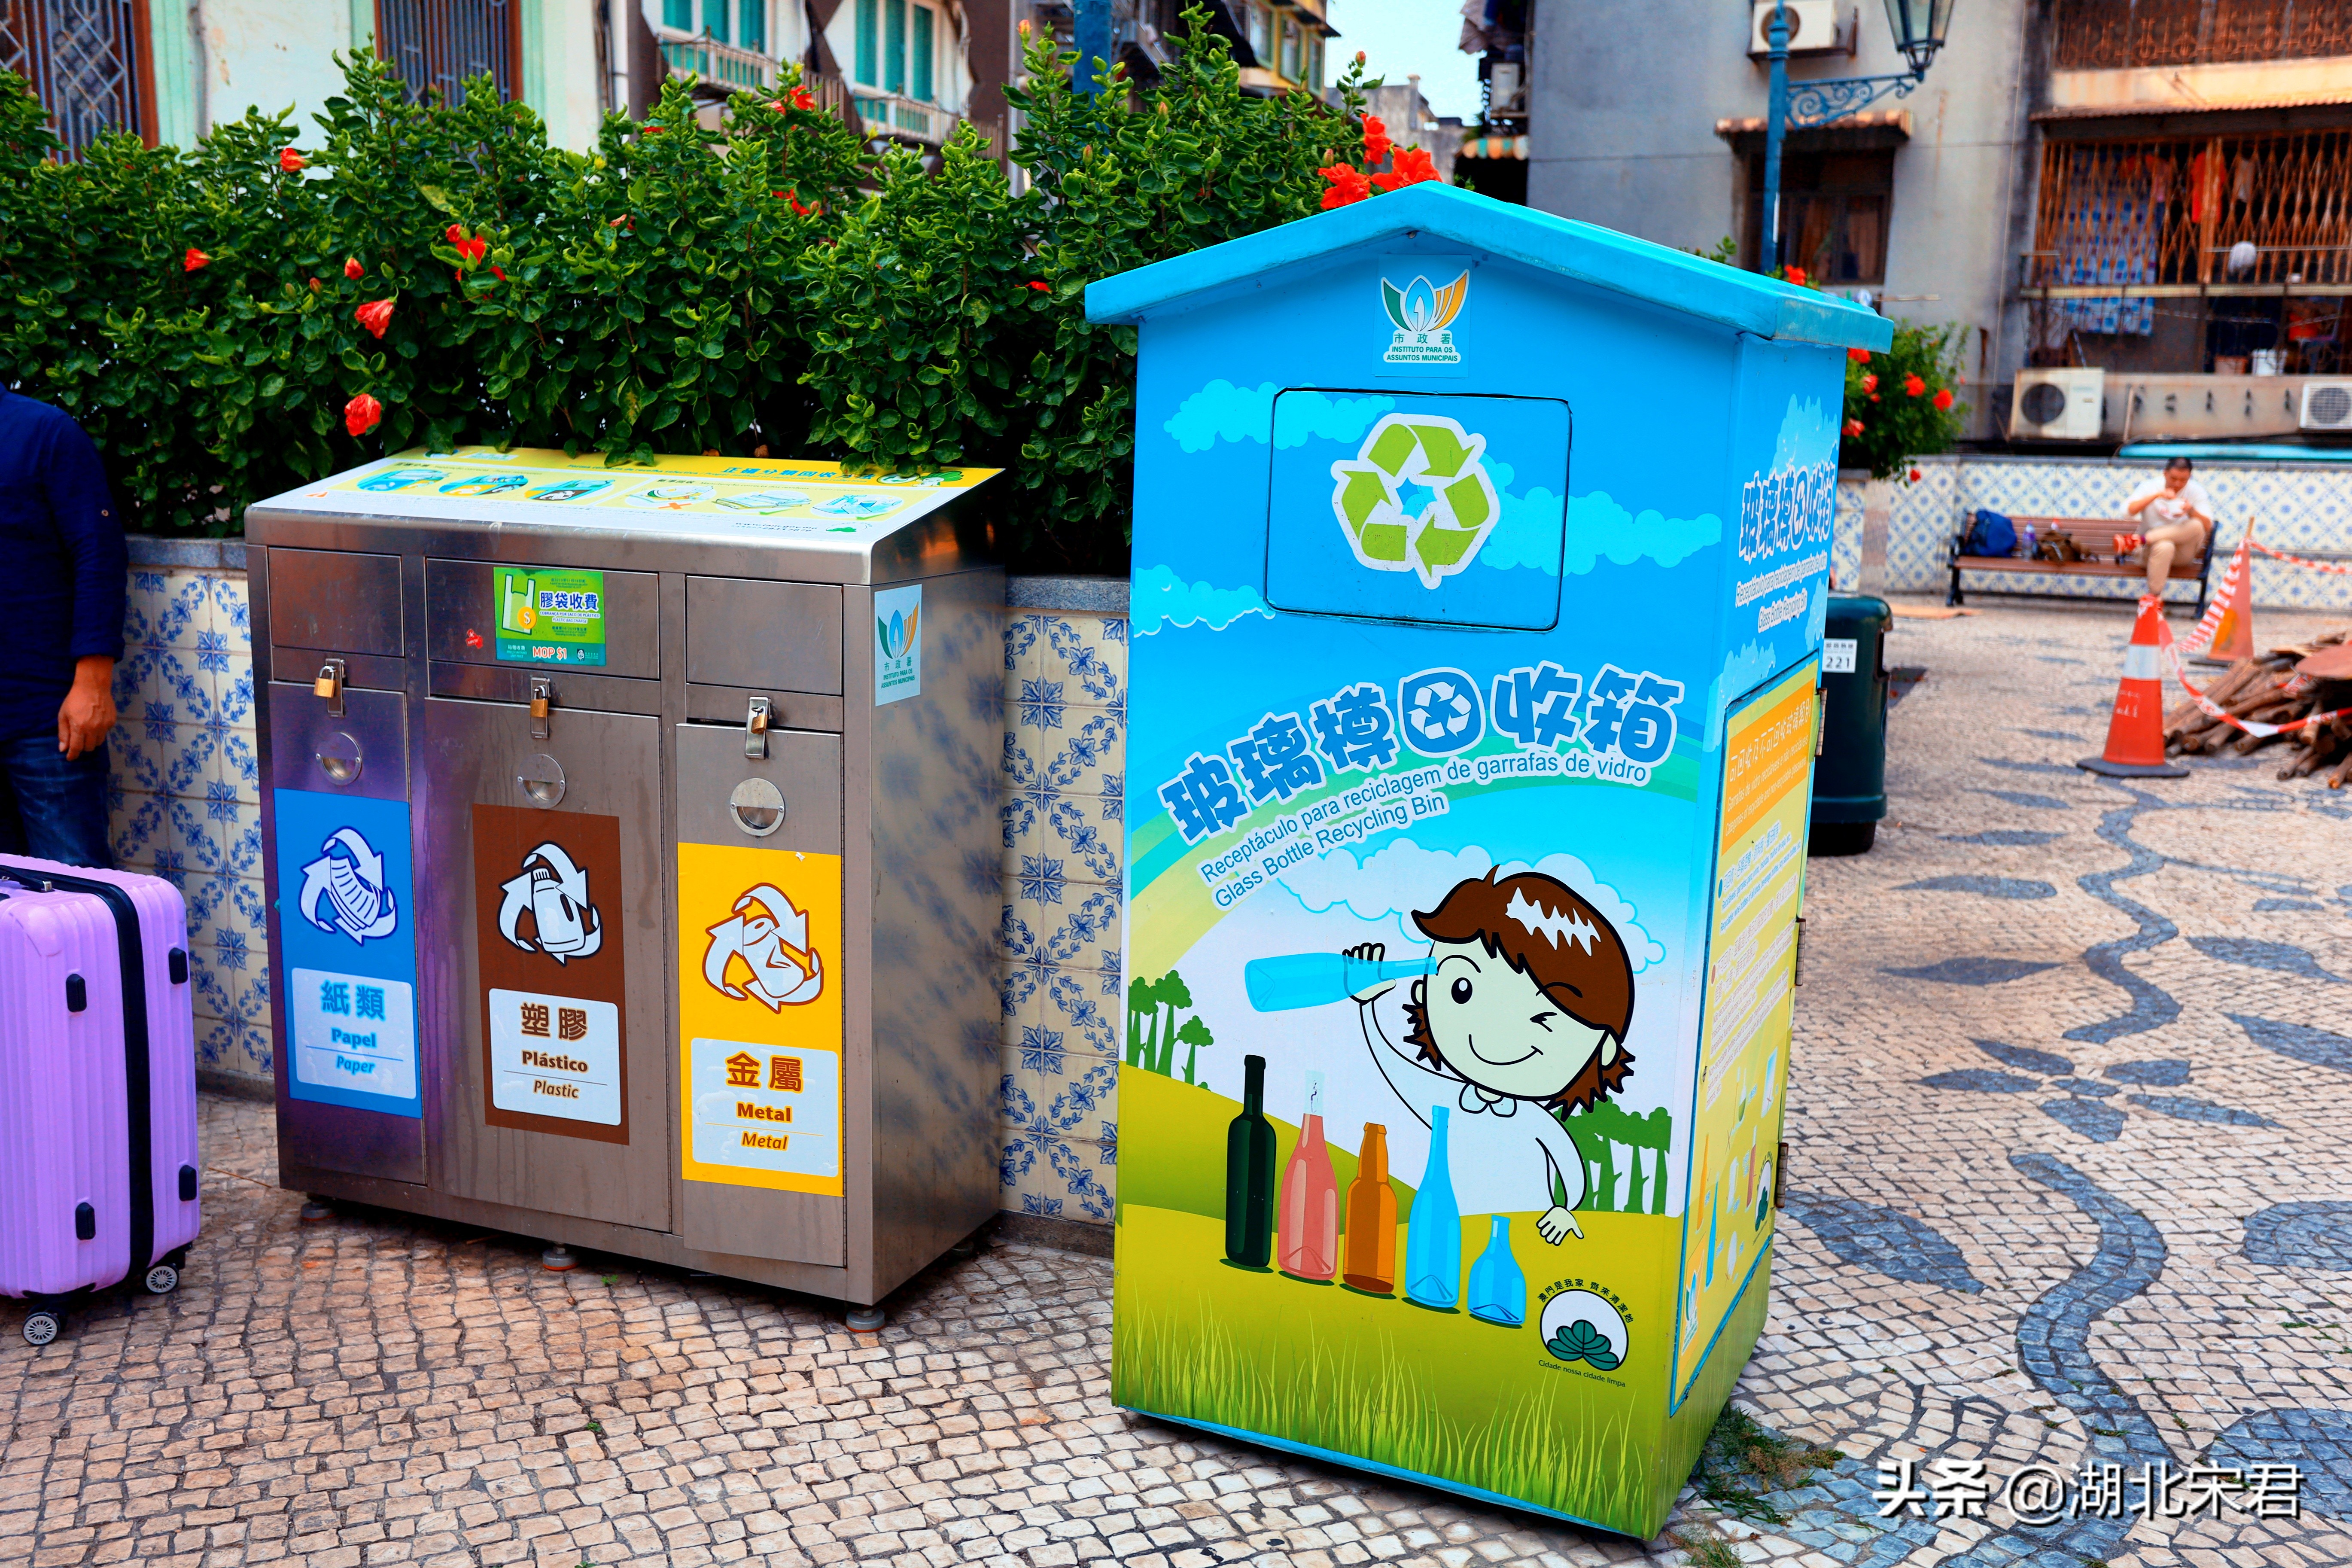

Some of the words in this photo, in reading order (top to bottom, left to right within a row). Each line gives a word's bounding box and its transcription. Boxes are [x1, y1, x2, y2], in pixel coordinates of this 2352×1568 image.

[1394, 333, 1451, 344] 市政署
[540, 592, 598, 611] 膠袋收費
[533, 647, 554, 658] MOP
[557, 647, 567, 660] $1
[1826, 655, 1850, 669] 221
[884, 656, 912, 672] 市政署
[881, 679, 898, 689] ASSUNTOS
[898, 675, 915, 684] MUNICIPAIS
[883, 671, 899, 680] INSTITUTO
[1201, 818, 1298, 883] Receptáculo
[1301, 800, 1340, 828] para
[1343, 768, 1441, 809] reciclagem
[1447, 761, 1471, 780] de
[1477, 752, 1558, 780] garrafas
[1565, 753, 1589, 773] de
[1597, 757, 1646, 782] vidro
[1215, 874, 1263, 907] Glass
[1262, 840, 1314, 876] Bottle
[1317, 804, 1408, 849] Recycling
[1411, 795, 1445, 816] Bin
[322, 981, 384, 1020] 紙類
[520, 1002, 587, 1040] 塑膠
[332, 1029, 376, 1048] Papel
[337, 1056, 374, 1074] Paper
[522, 1051, 588, 1072] Plástico
[727, 1053, 801, 1092] 金屬
[534, 1080, 579, 1098] Plastic
[737, 1103, 791, 1122] Metal
[742, 1133, 788, 1150] Metal
[1537, 1278, 1584, 1303] 澳門是我家
[1589, 1281, 1634, 1324] 齊來清潔她
[1538, 1359, 1561, 1371] Cidade
[1563, 1367, 1582, 1376] nossa
[1583, 1371, 1605, 1382] cidade
[1607, 1376, 1626, 1388] limpa
